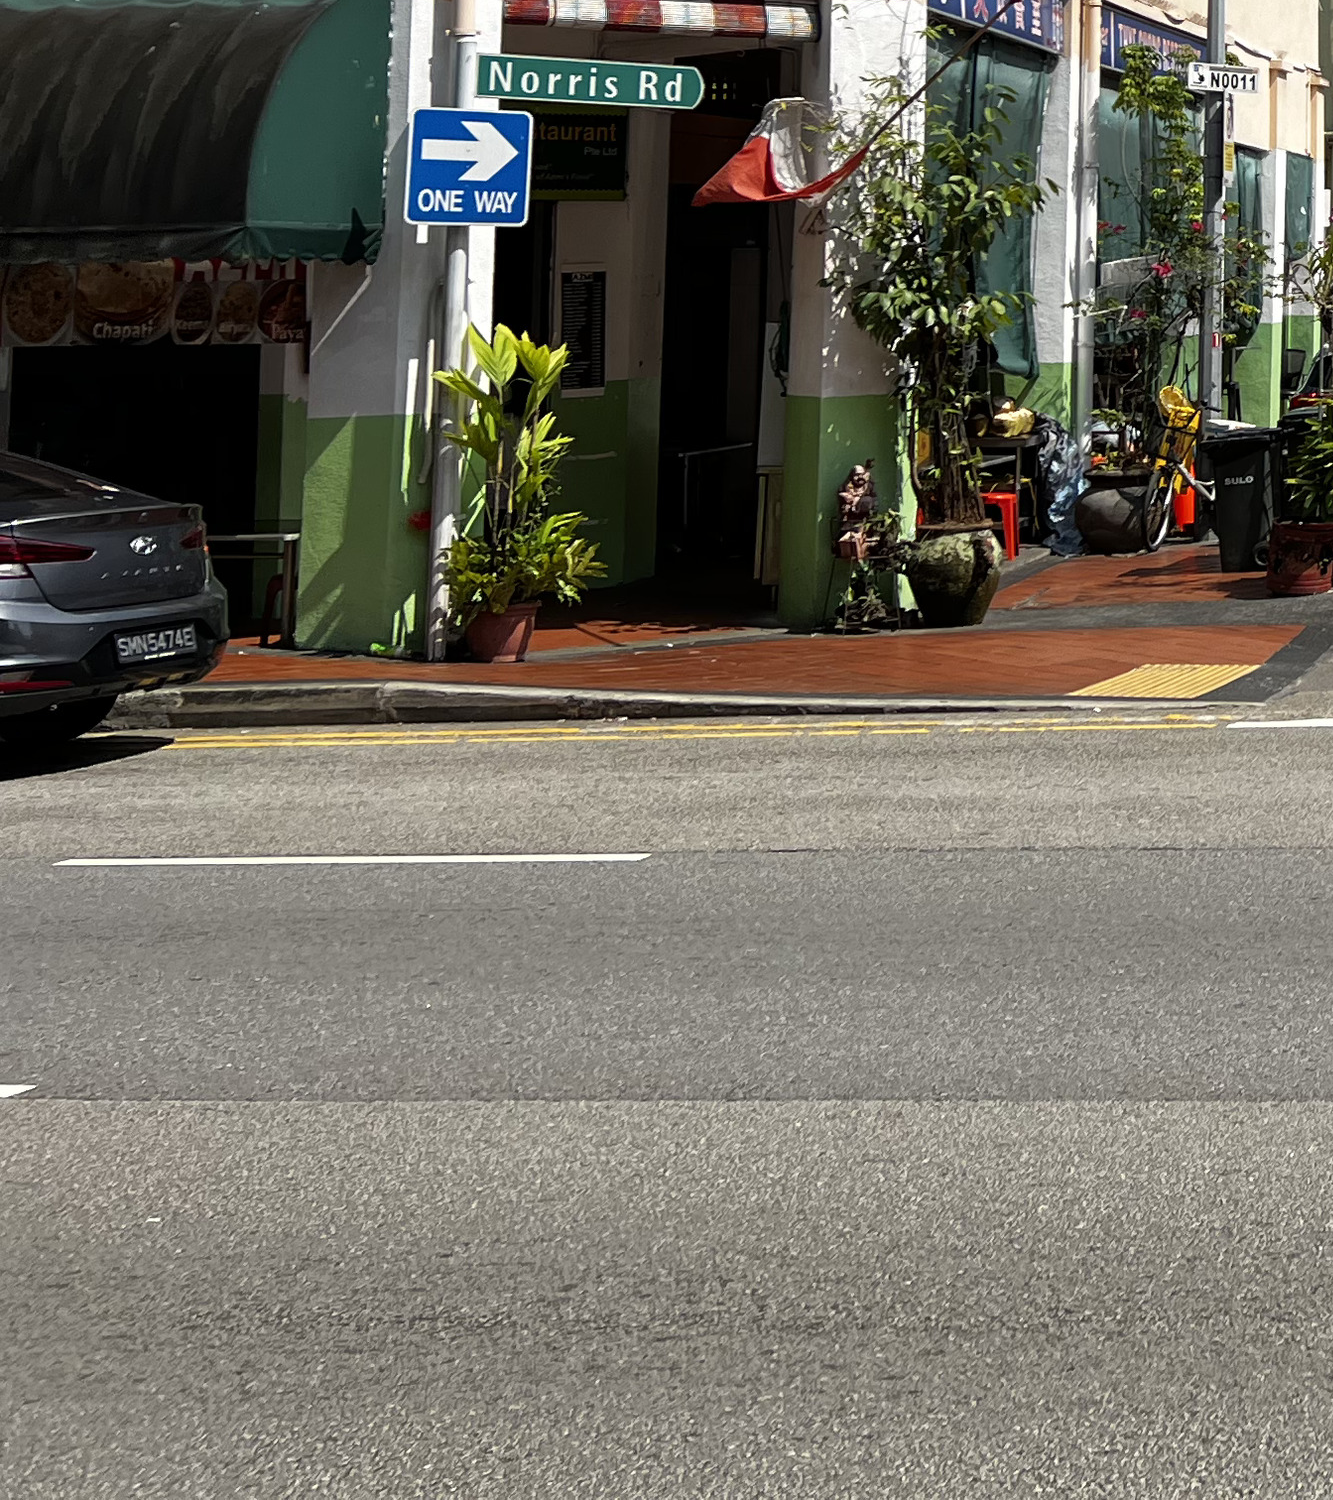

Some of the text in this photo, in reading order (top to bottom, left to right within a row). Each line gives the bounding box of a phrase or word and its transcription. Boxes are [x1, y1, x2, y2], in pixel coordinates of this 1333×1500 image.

[489, 61, 683, 102] Norris Rd
[417, 188, 518, 214] ONE WAY
[93, 320, 155, 341] Chapati
[1224, 475, 1254, 486] SULO
[117, 626, 196, 657] SMN5474E
